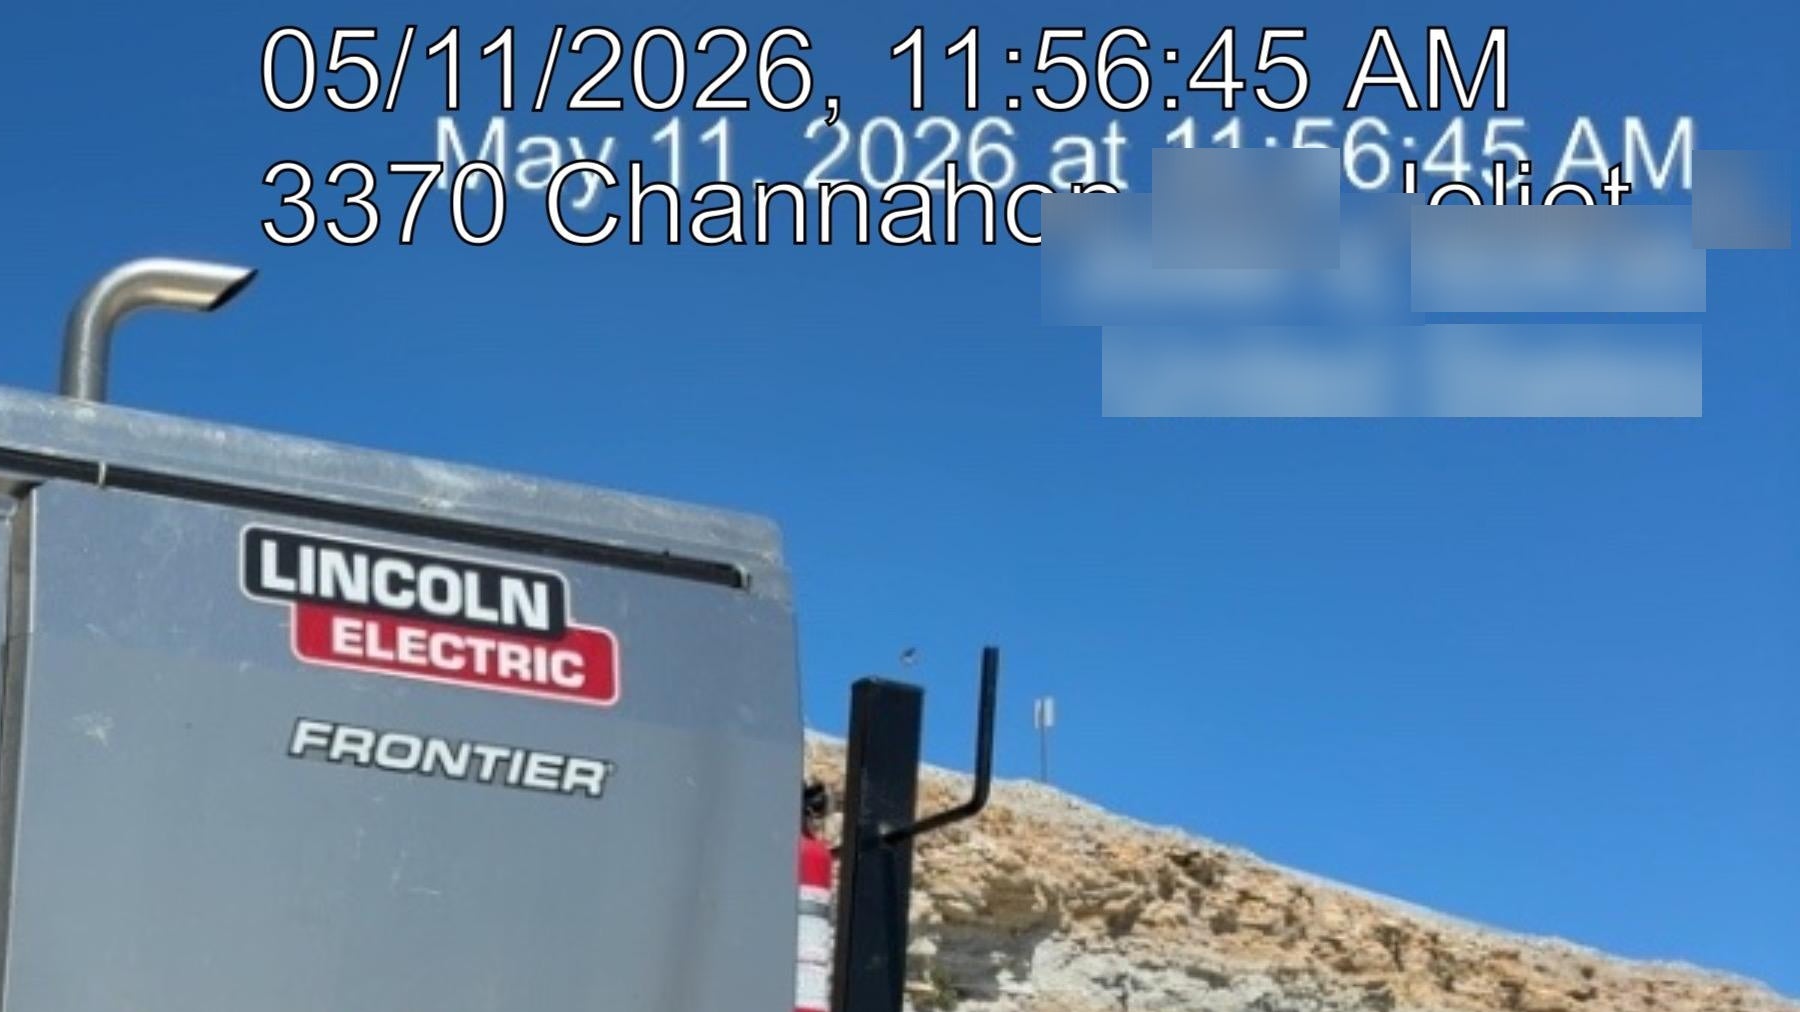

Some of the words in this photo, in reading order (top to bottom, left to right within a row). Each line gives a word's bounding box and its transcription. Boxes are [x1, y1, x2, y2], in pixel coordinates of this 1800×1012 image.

[260, 539, 550, 632] LINCOLN
[331, 615, 586, 689] ELECTRIC
[288, 717, 610, 798] FRONTIER
